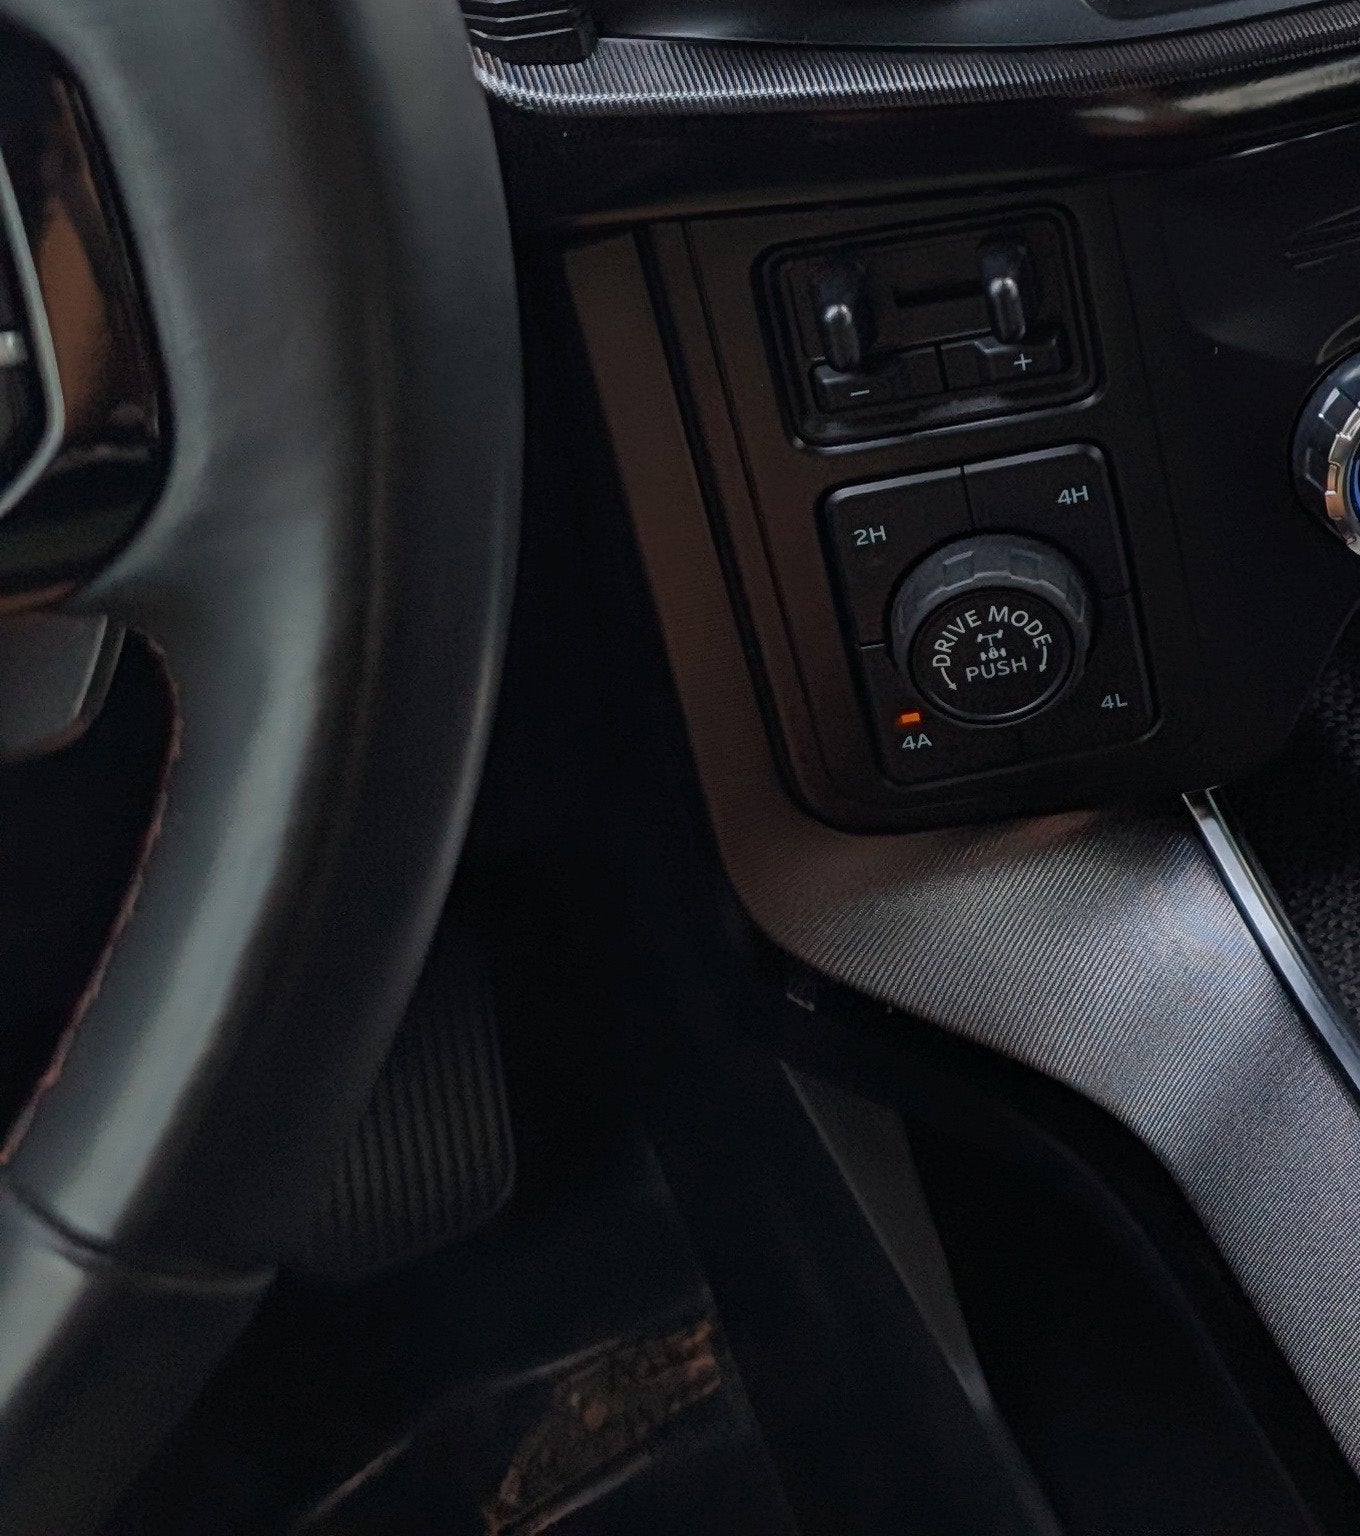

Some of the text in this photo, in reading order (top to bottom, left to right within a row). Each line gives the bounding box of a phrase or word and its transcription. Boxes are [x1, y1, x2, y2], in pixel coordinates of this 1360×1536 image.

[1057, 485, 1089, 506] 4H
[854, 526, 887, 546] 2H
[933, 605, 1053, 668] DRIVE MODE
[966, 656, 1028, 683] PUSH
[1101, 693, 1128, 710] 4L
[901, 734, 932, 751] 4A
